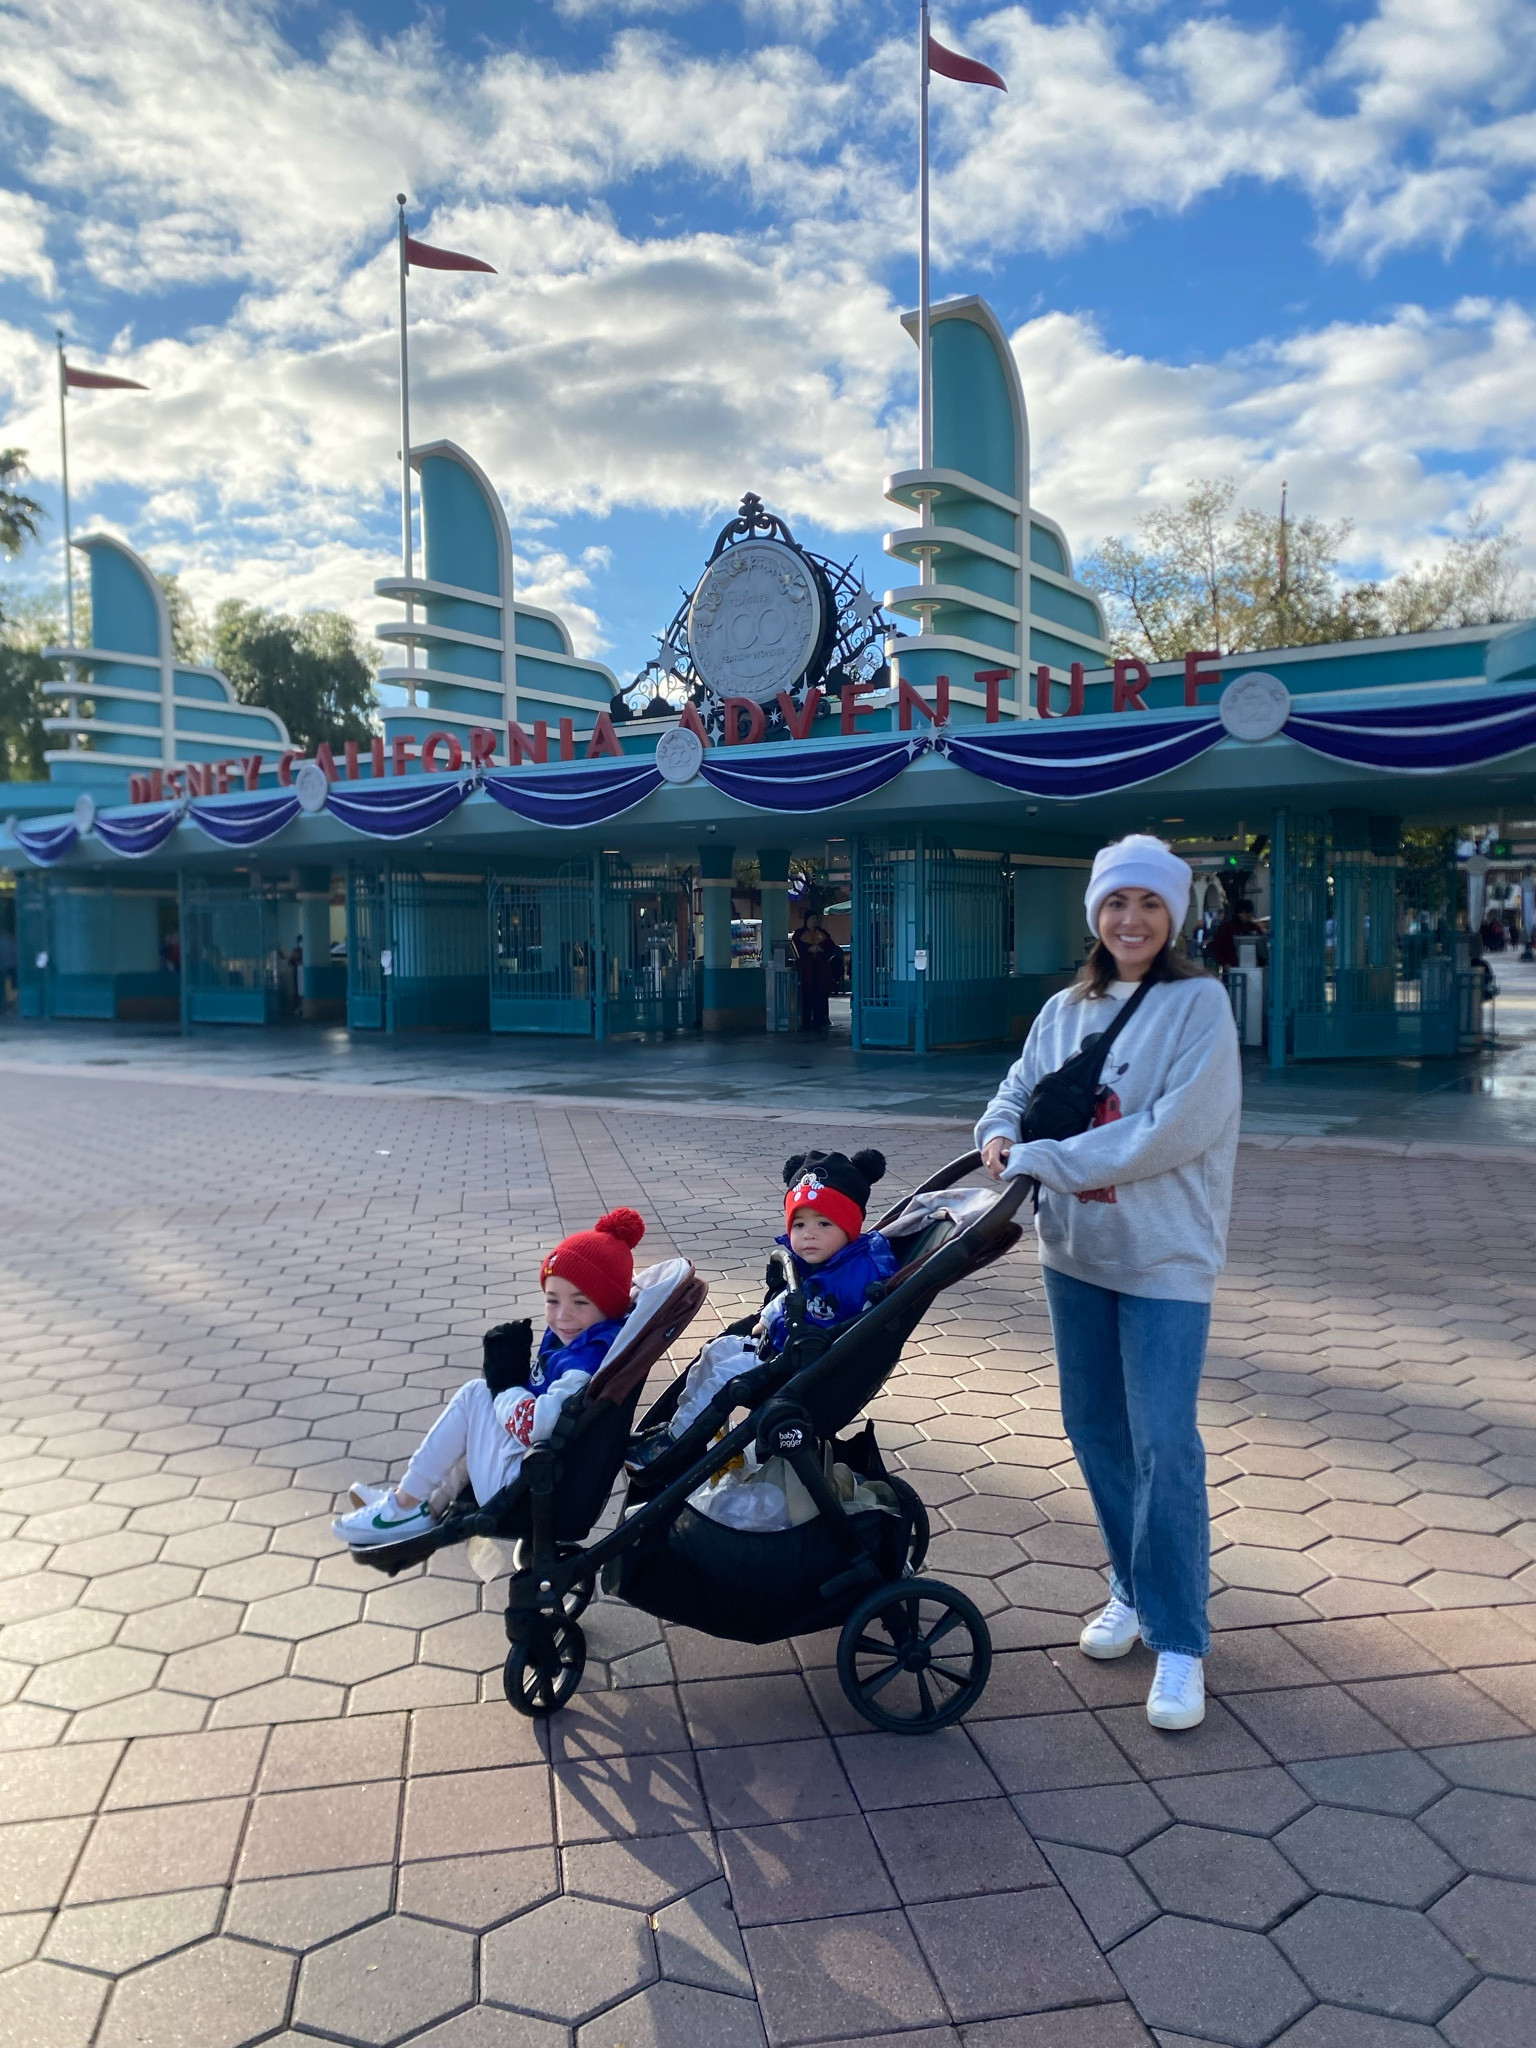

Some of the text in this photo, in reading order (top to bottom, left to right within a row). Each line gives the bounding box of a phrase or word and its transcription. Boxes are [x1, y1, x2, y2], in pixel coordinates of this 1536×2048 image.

[715, 608, 788, 652] 100
[130, 755, 263, 804] DISNEY
[779, 1431, 796, 1440] baby
[780, 1439, 802, 1448] jogger
